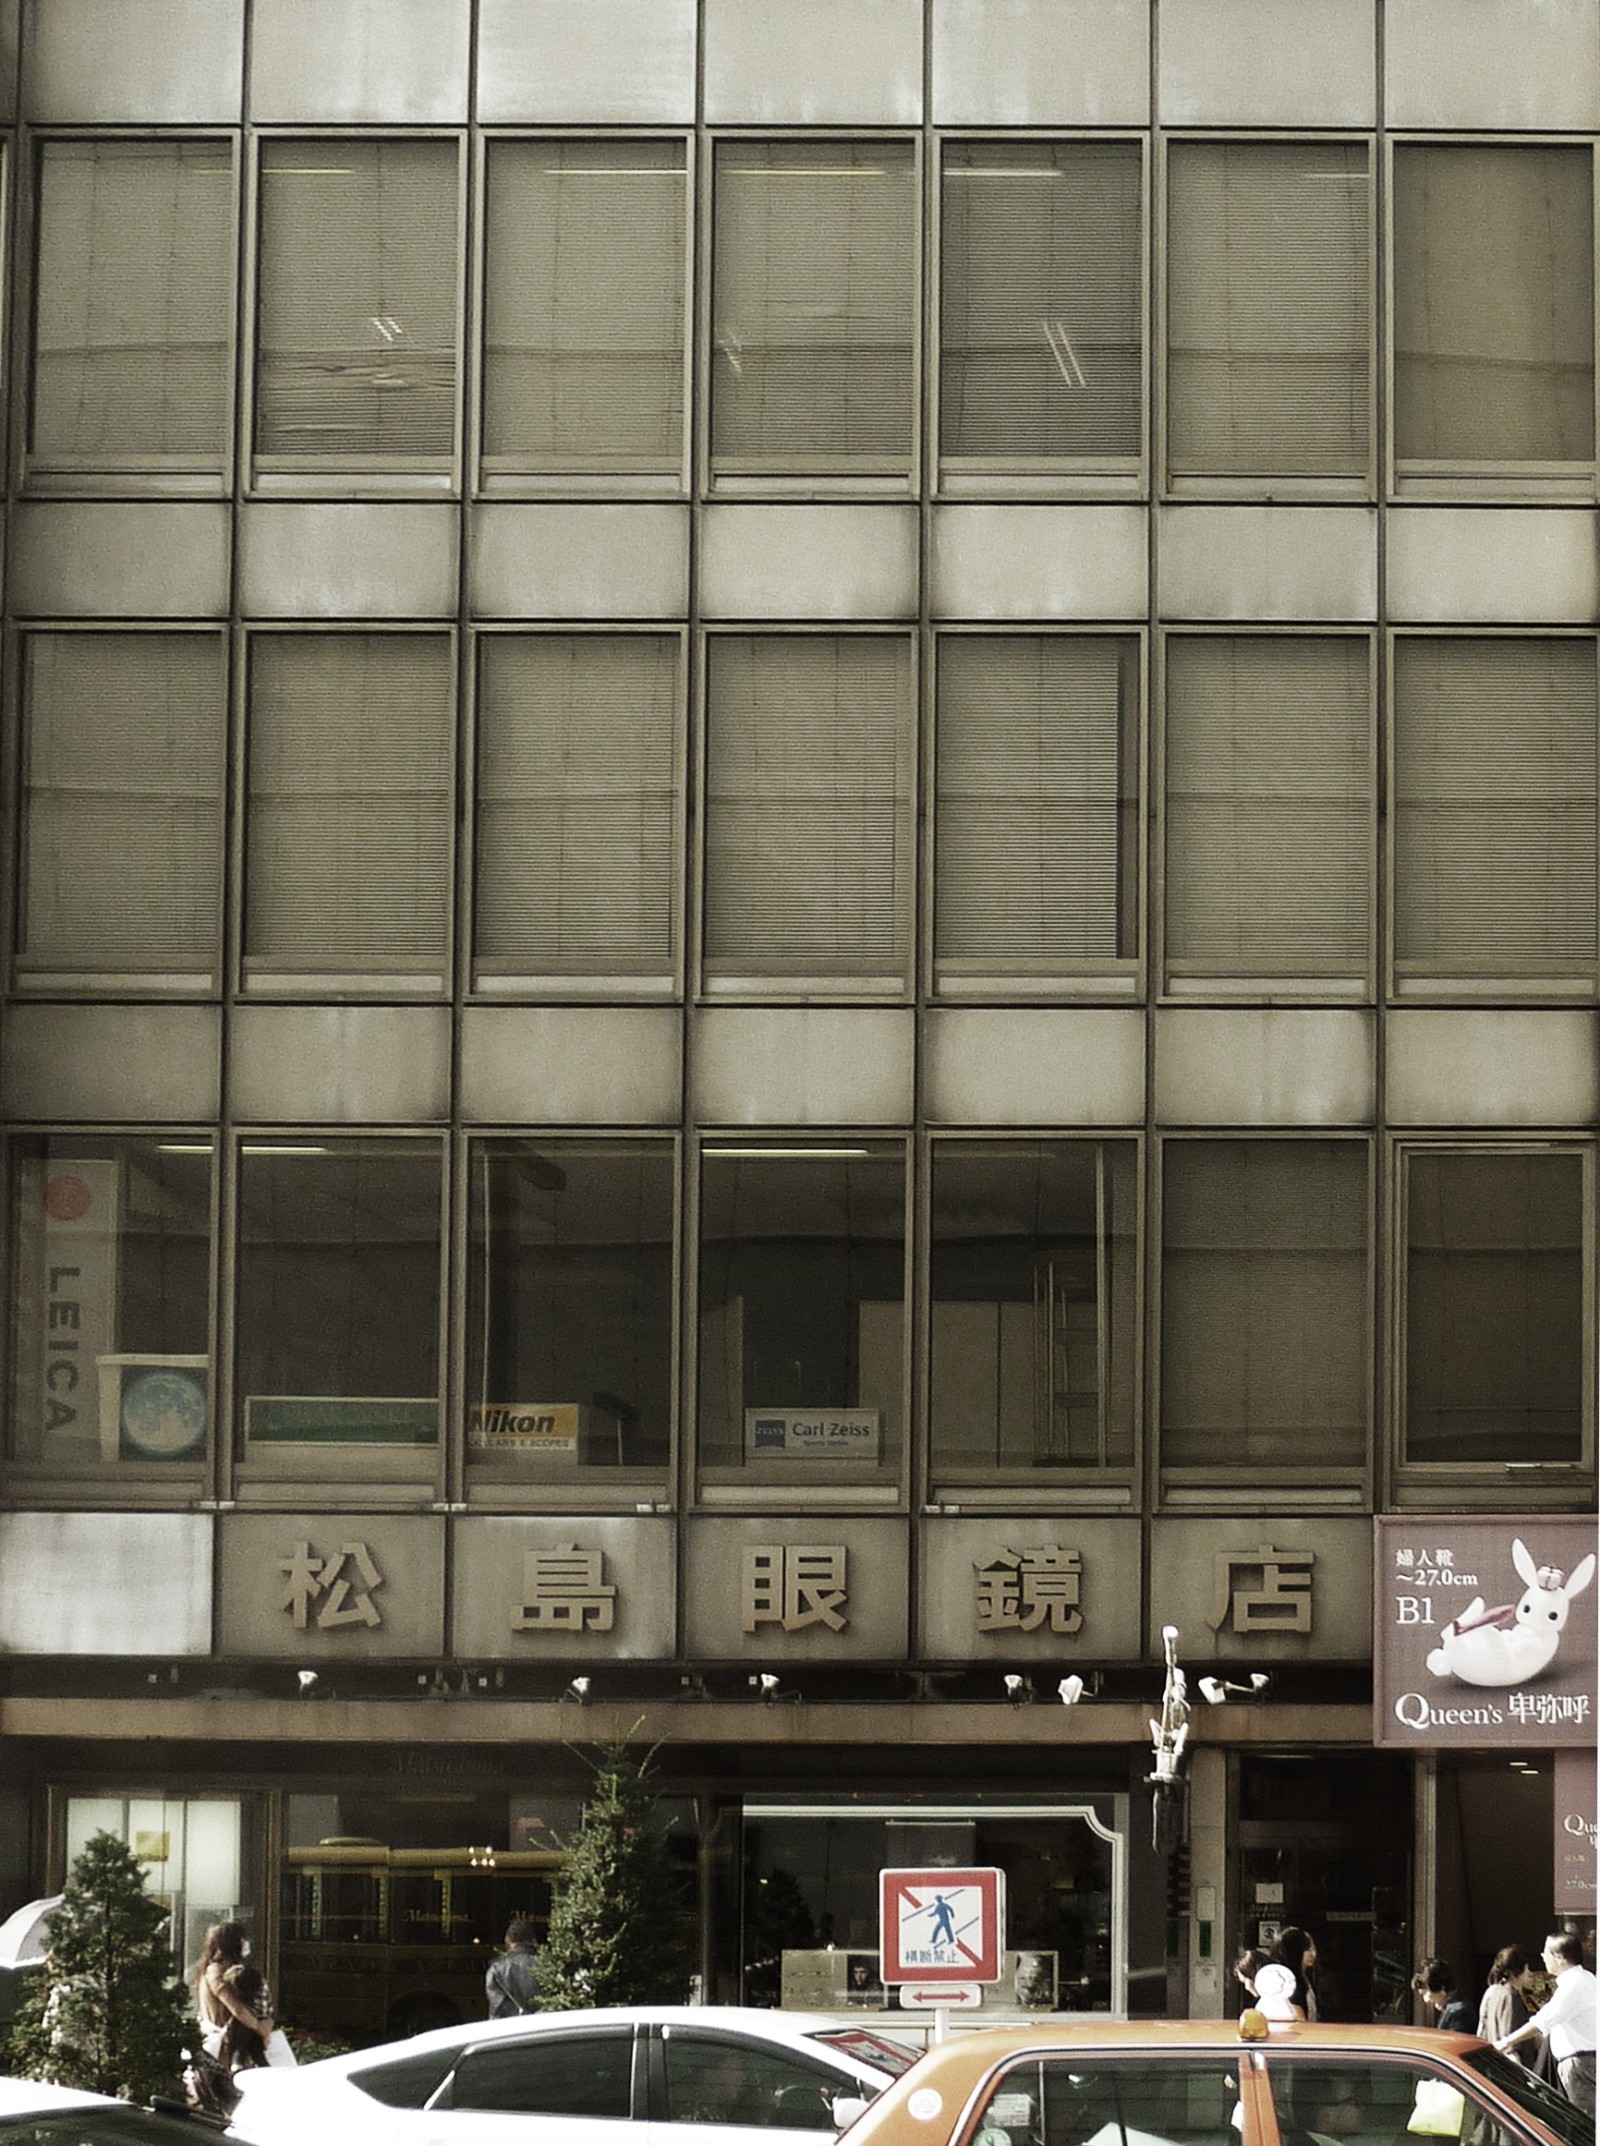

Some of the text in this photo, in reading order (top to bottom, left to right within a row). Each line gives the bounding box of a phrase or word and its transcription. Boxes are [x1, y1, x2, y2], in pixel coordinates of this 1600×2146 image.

[46, 1266, 80, 1430] LEICA
[468, 1410, 555, 1433] Nikon
[793, 1422, 870, 1436] Carl Zeiss
[276, 1539, 1315, 1634] 松島眼鏡店
[1395, 1597, 1435, 1624] B1
[1507, 1692, 1591, 1725] 卑弥呼
[905, 1949, 960, 1964] 横断禁止
